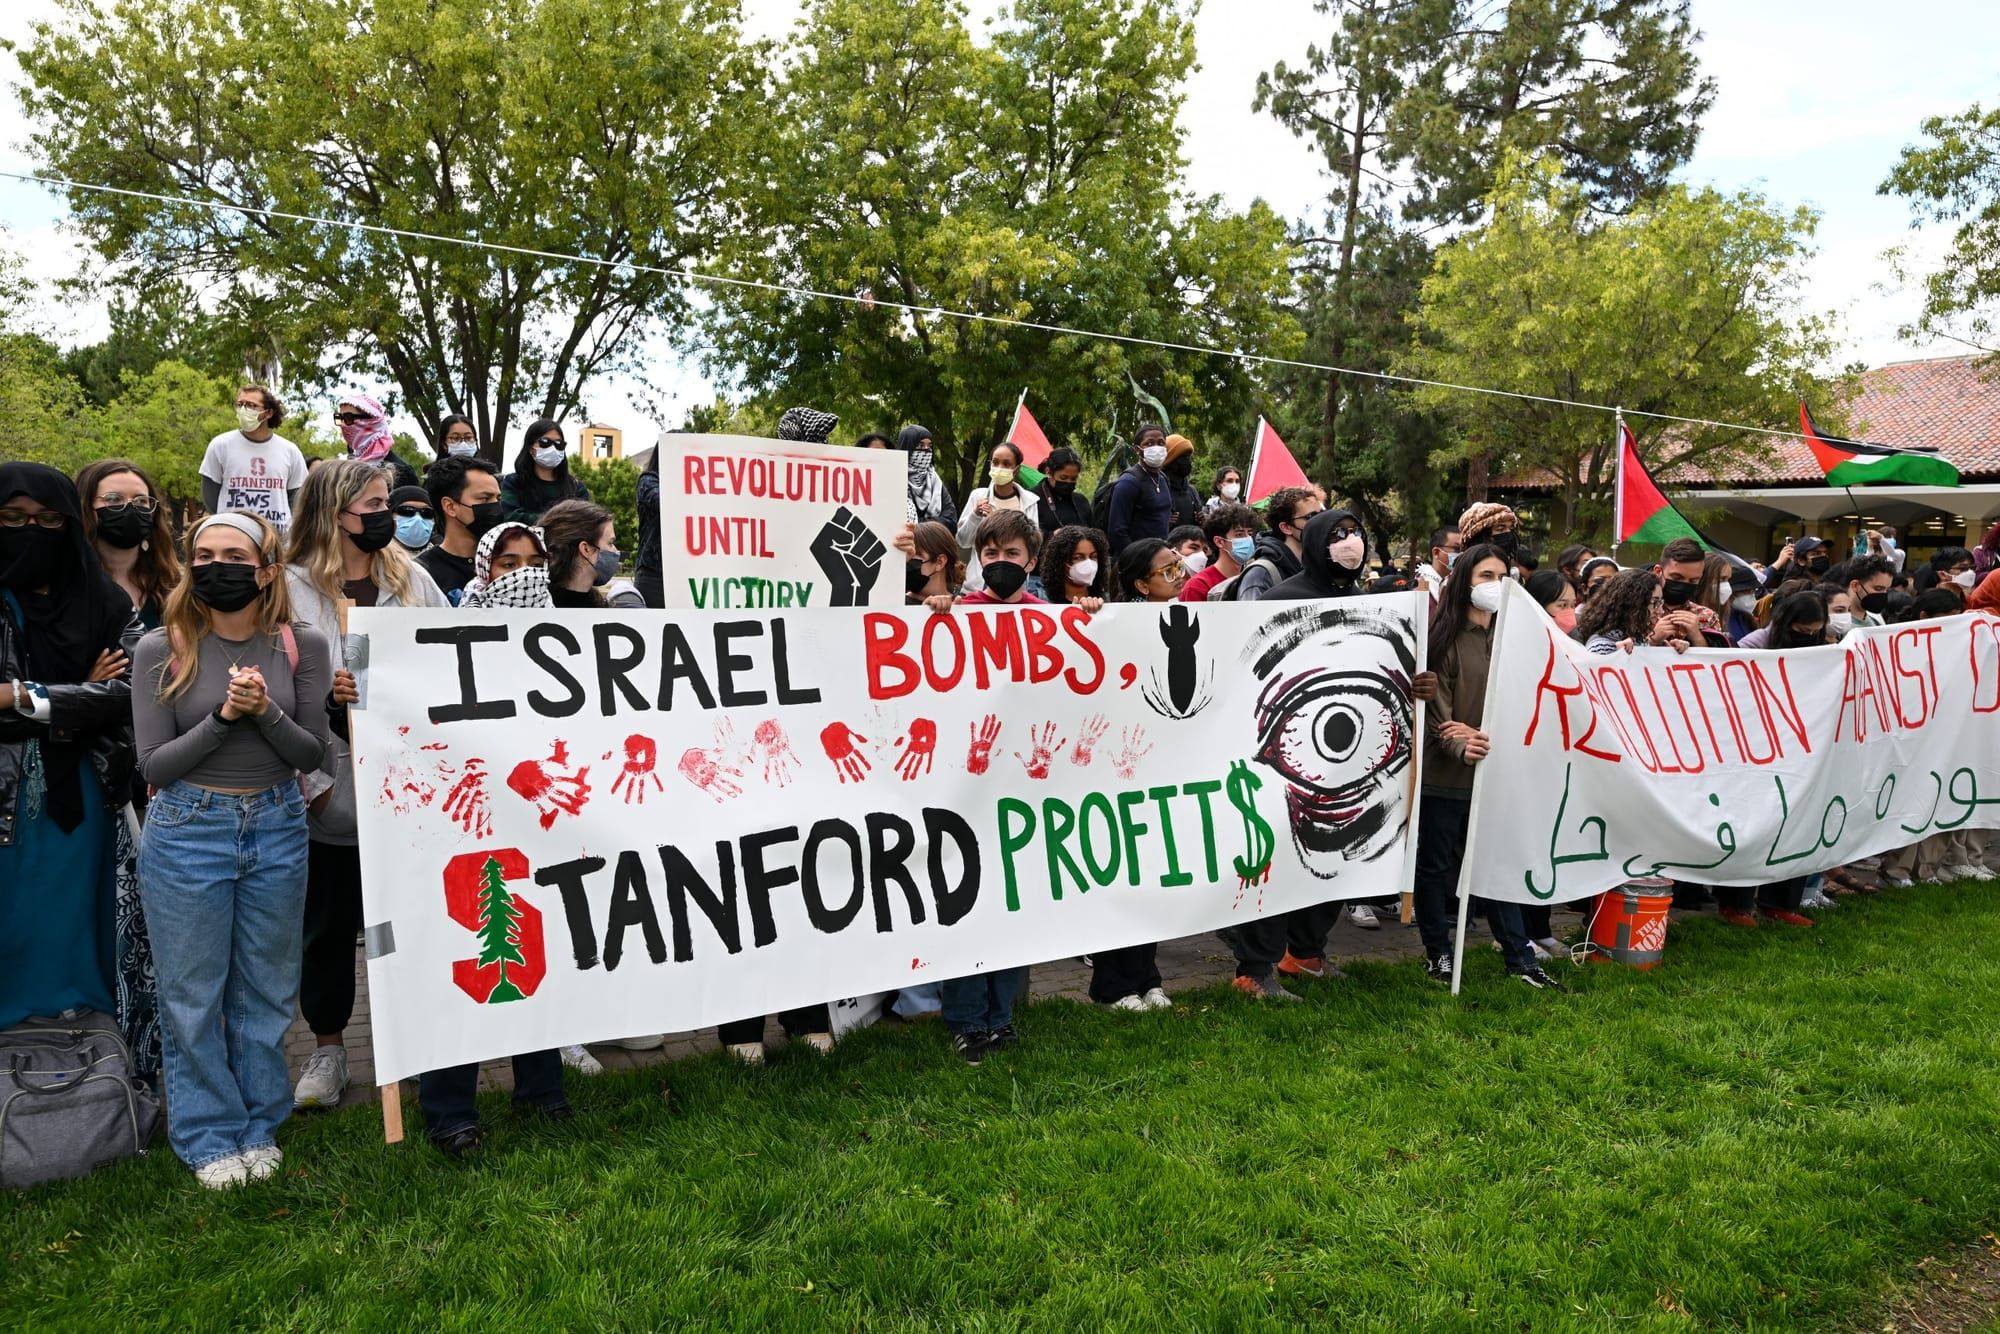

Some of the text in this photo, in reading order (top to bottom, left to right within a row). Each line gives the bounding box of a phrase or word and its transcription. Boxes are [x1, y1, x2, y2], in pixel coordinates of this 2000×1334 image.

[226, 488, 270, 508] JEWS
[684, 456, 872, 506] REVOLUTION
[685, 516, 774, 558] UNTIL
[688, 576, 814, 608] VICTORY
[415, 606, 1137, 722] ISRAEL BOMBS,
[443, 807, 981, 1005] STANFORD
[1635, 917, 1658, 937] THE
